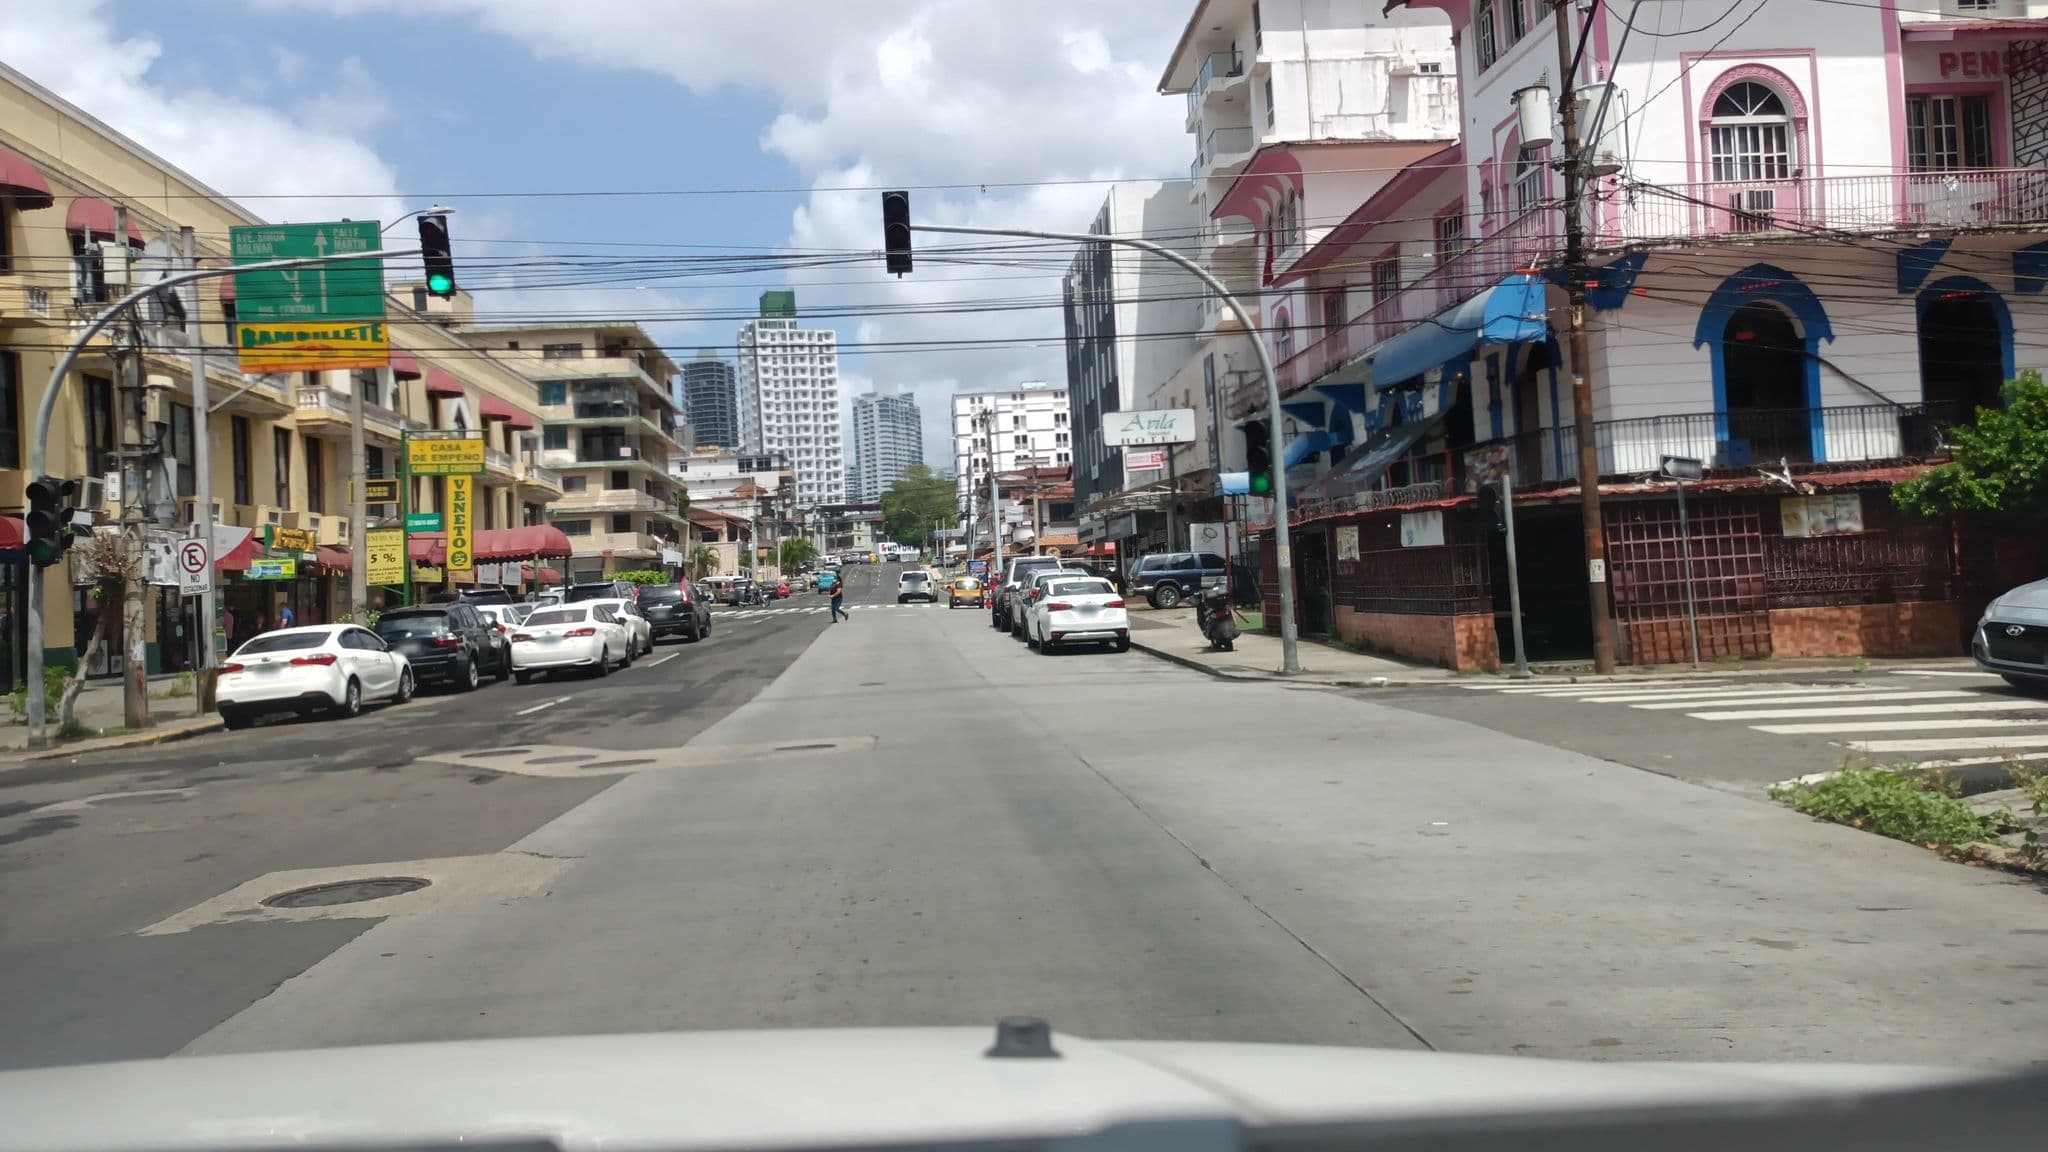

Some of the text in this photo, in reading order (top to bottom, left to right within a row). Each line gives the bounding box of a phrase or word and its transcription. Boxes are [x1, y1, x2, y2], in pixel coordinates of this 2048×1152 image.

[333, 228, 360, 237] CALLE
[334, 239, 367, 250] MARTIN
[280, 304, 315, 316] CENTRAL
[1121, 434, 1180, 444] HOTEL
[430, 444, 462, 452] CASA
[412, 454, 427, 462] DE
[453, 479, 466, 549] VENETO
[370, 552, 396, 564] 5 %
[190, 574, 201, 583] NO
[183, 584, 208, 594] ESTACIONAR
